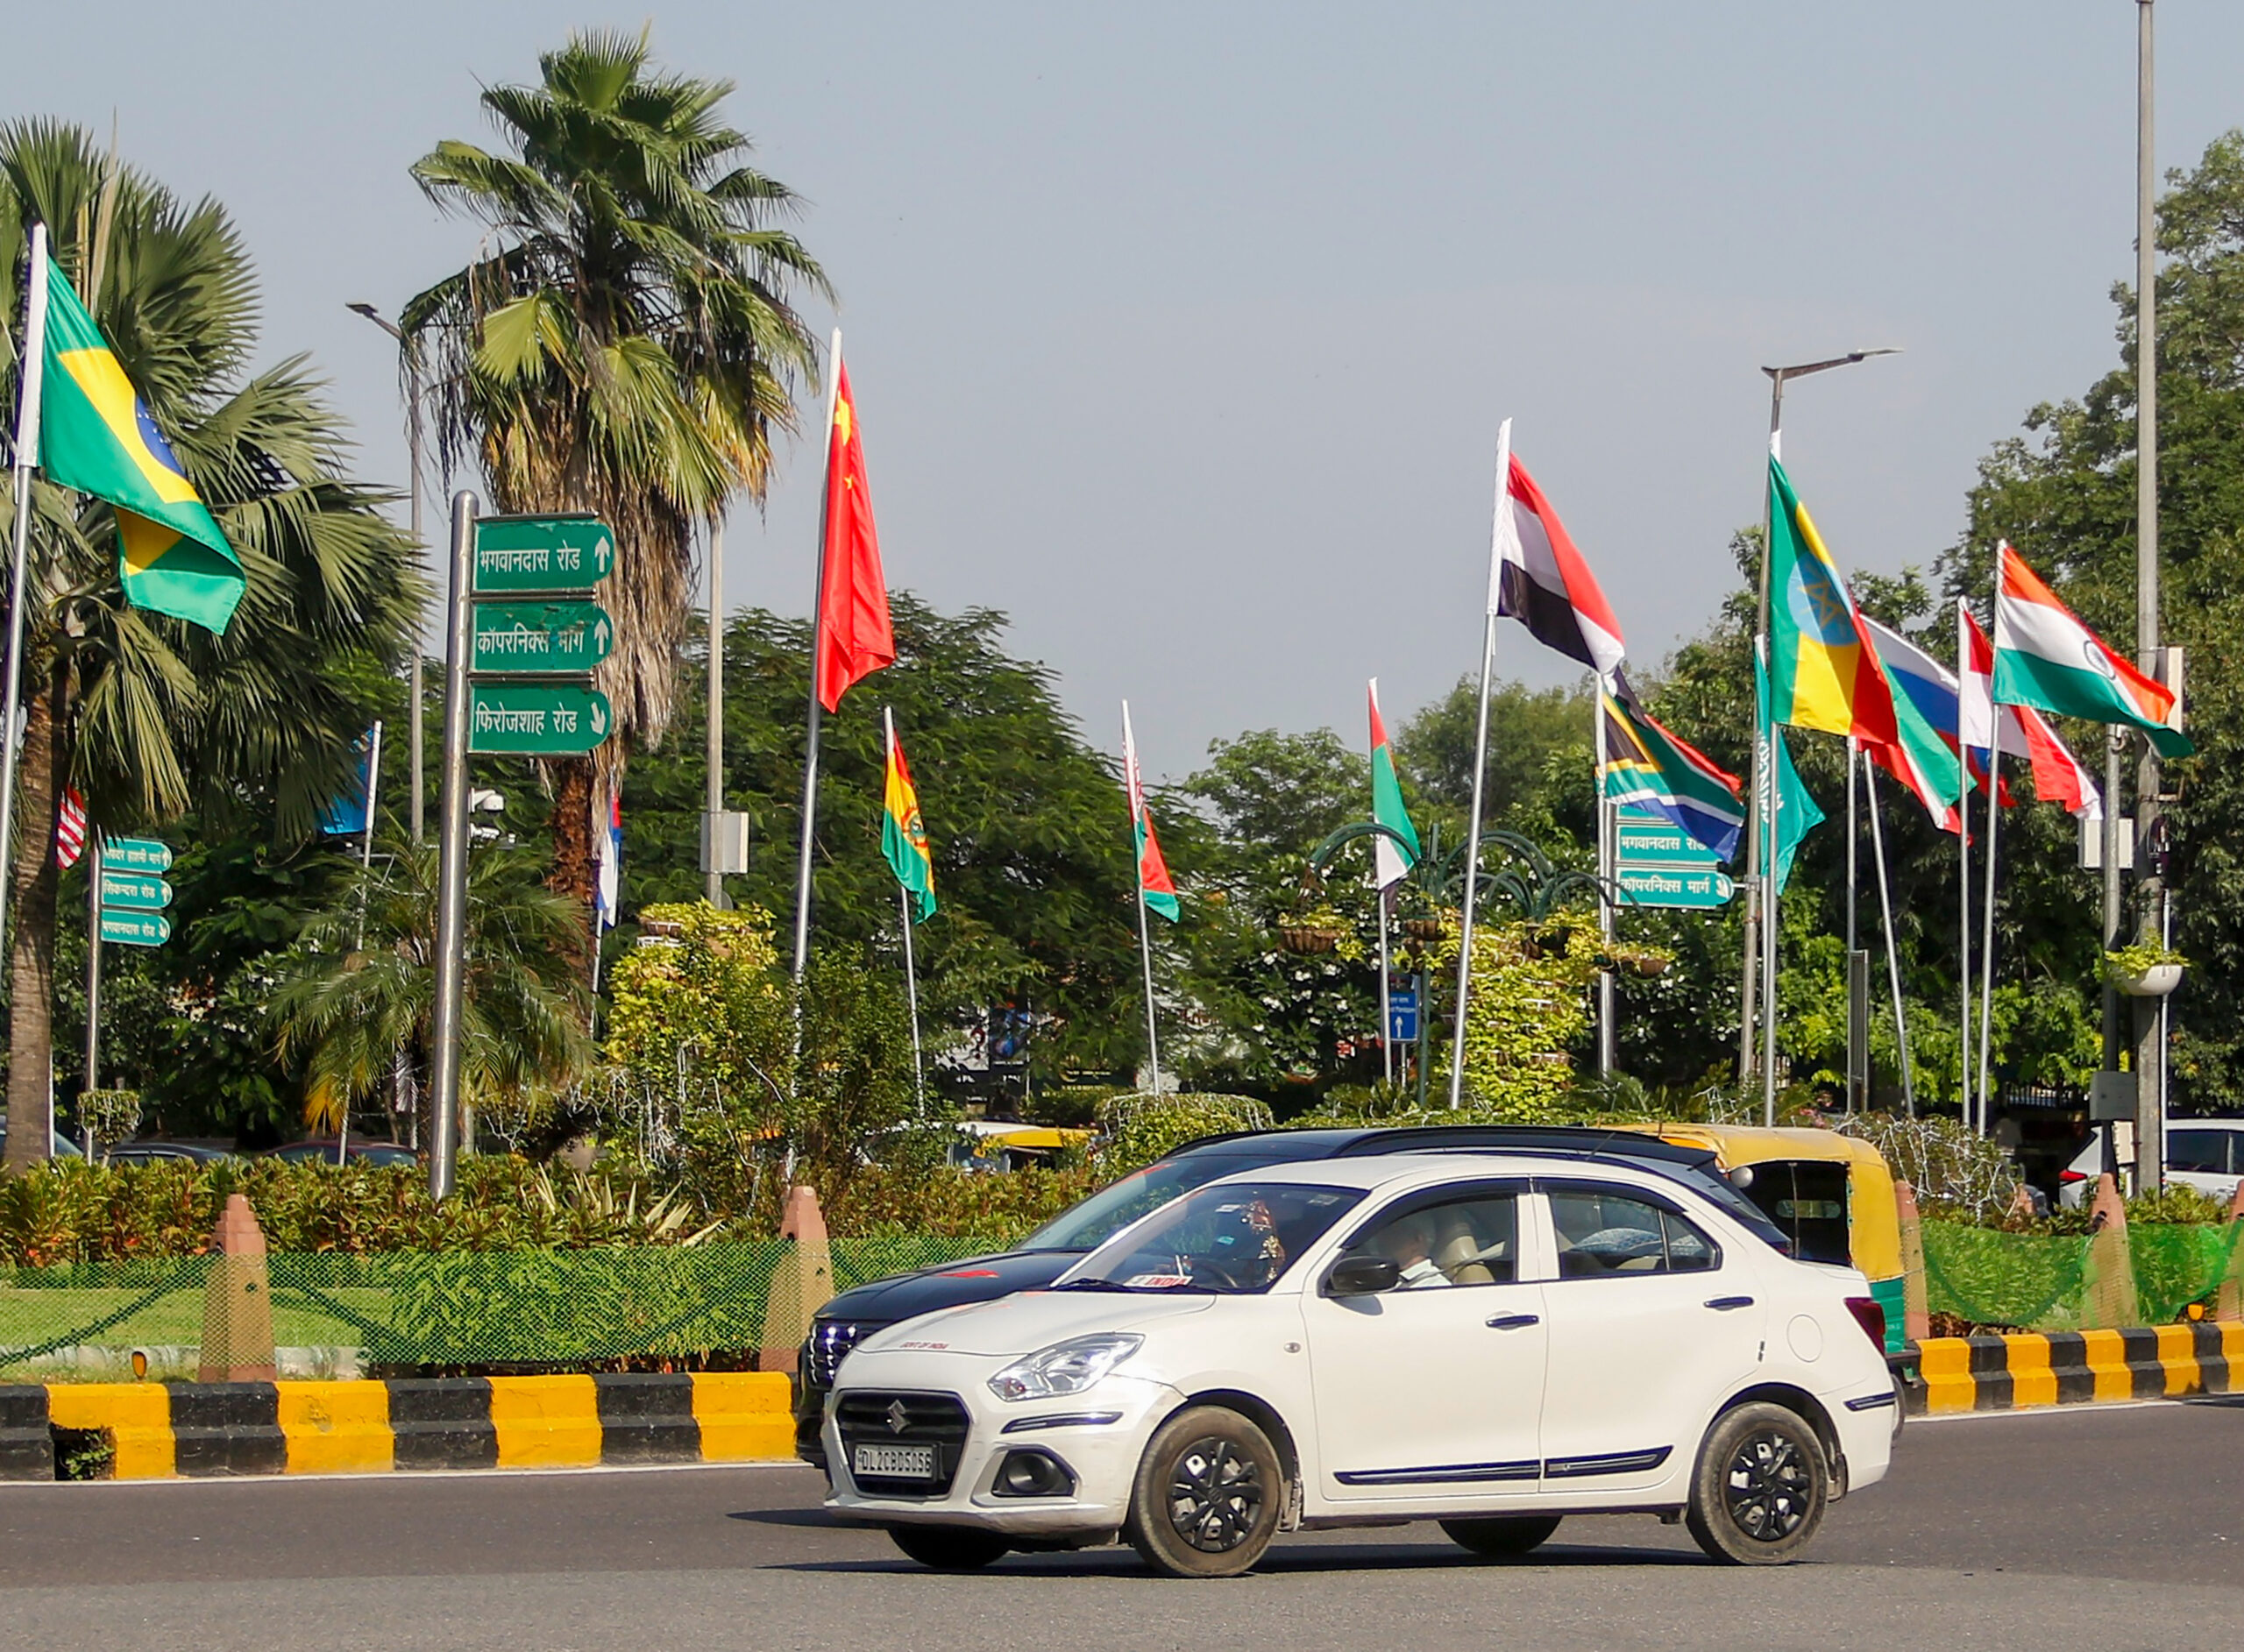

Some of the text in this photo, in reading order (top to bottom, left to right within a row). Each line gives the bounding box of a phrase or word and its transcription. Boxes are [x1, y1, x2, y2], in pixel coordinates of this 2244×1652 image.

[479, 539, 581, 573] भगवानदास रोड
[475, 701, 579, 736] फिरोजशाह रोड
[1687, 876, 1710, 894] मार्ग
